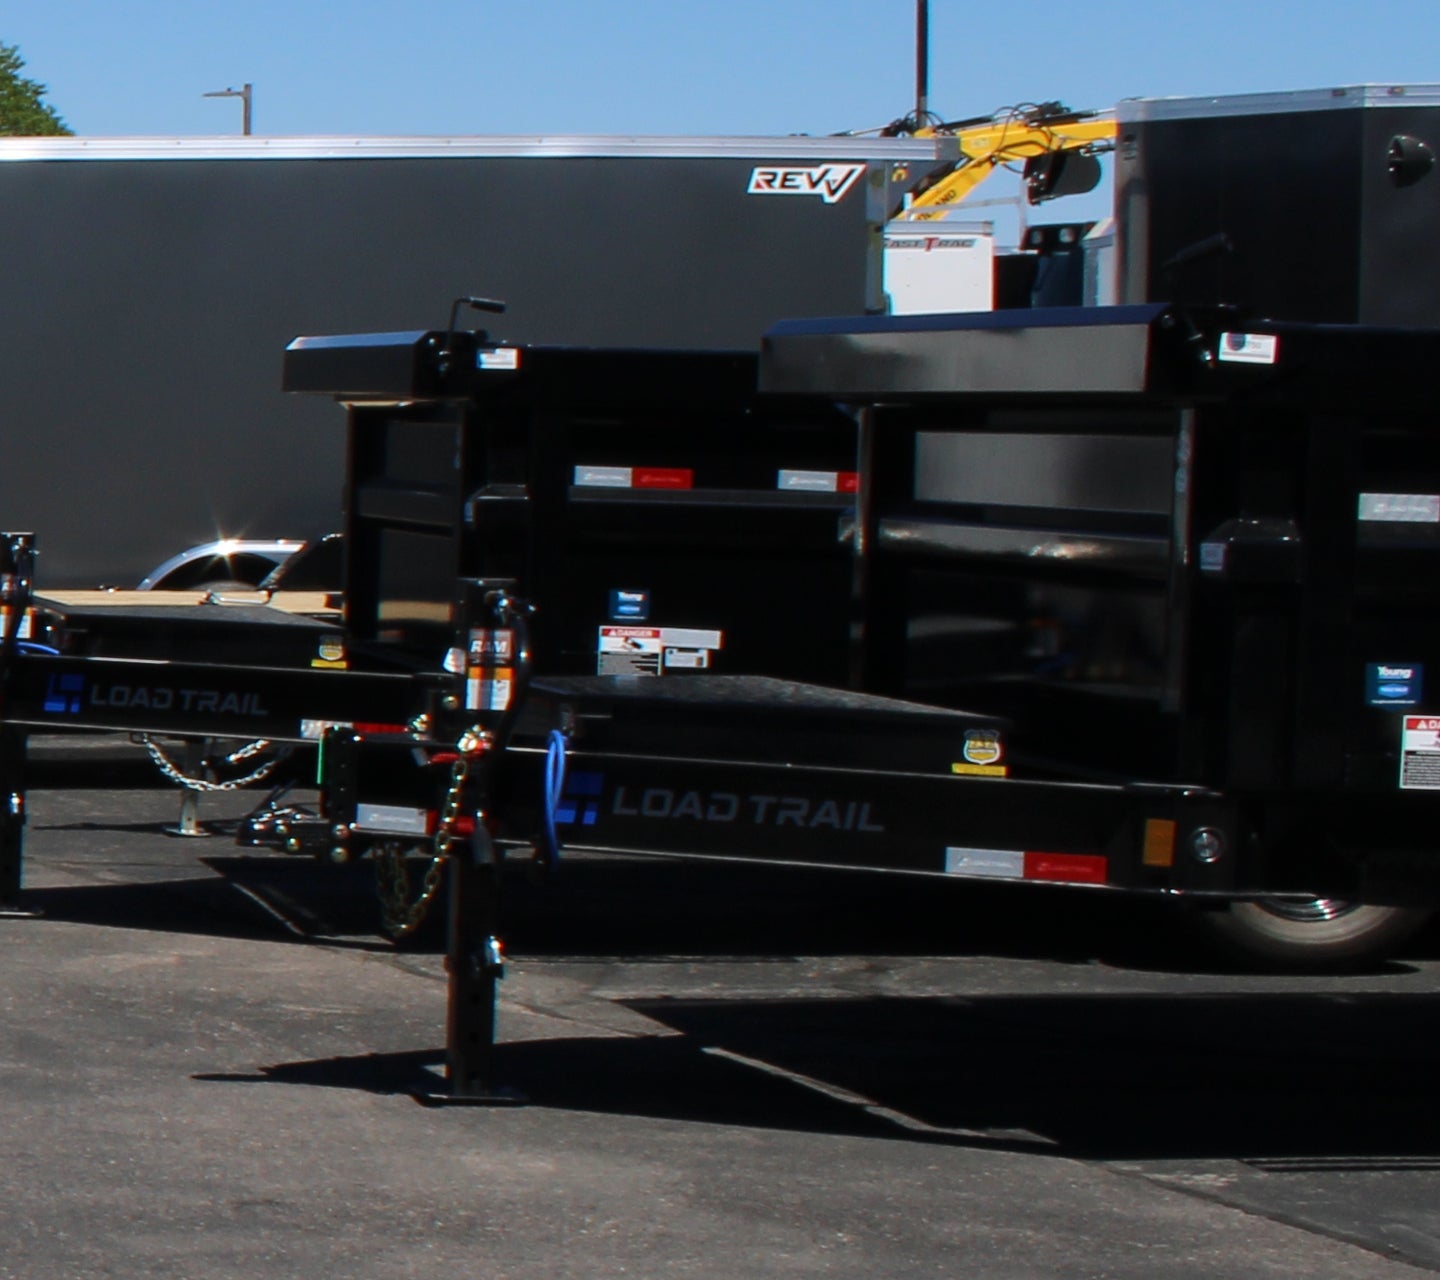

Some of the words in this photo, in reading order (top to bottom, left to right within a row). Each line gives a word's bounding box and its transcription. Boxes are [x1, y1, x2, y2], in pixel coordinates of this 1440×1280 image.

[90, 685, 175, 708] LOAD
[179, 689, 269, 715] TRAIL
[612, 786, 739, 821] LOAD
[748, 795, 884, 832] TRAIL
